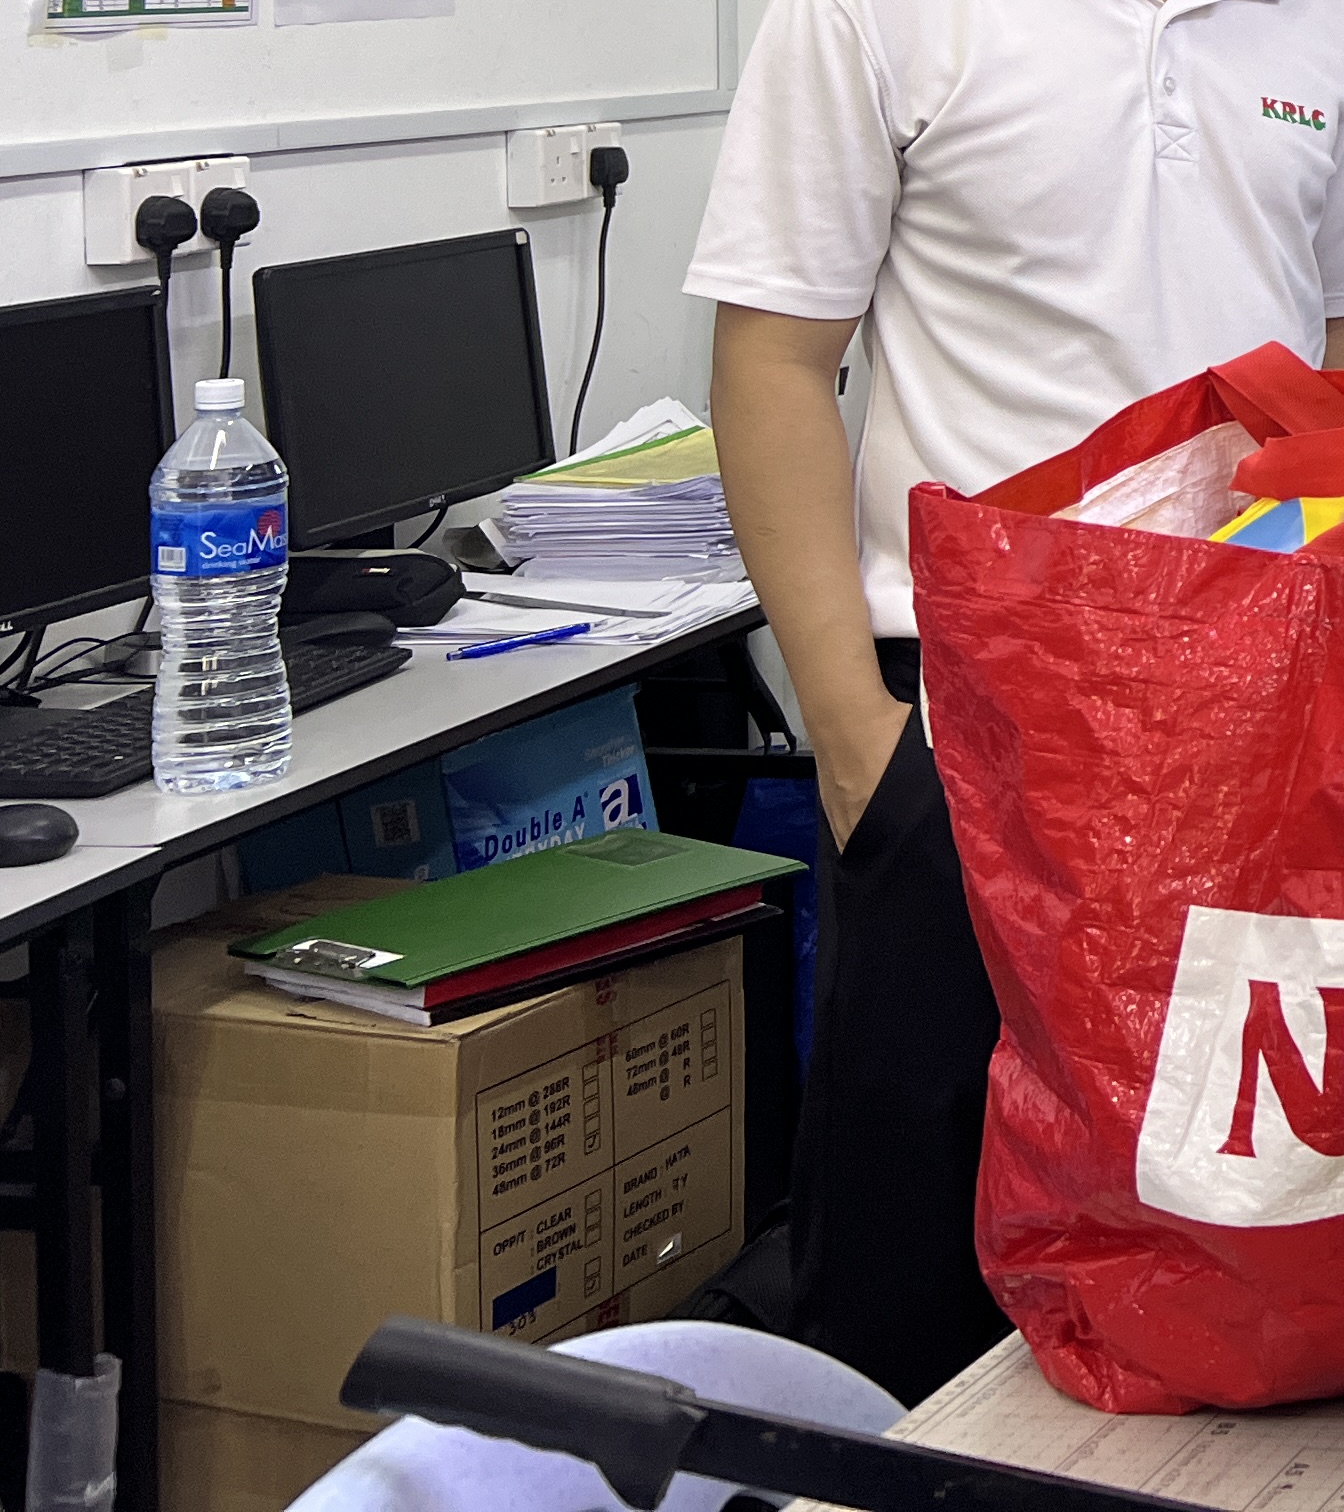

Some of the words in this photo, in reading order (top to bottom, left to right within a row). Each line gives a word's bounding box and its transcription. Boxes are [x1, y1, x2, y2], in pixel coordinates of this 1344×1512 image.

[1260, 96, 1326, 131] KRLC
[484, 809, 563, 863] Double
[572, 796, 586, 823] A
[683, 1057, 690, 1070] R
[684, 1075, 690, 1088] R
[492, 1100, 525, 1123] 12mm
[528, 1091, 540, 1107] @
[528, 1109, 541, 1126] @
[543, 1094, 570, 1116] 192R
[492, 1136, 526, 1160] 24mm
[529, 1127, 541, 1144] @
[544, 1112, 571, 1135] 144R
[492, 1154, 527, 1179] 36mm
[529, 1146, 541, 1163] @
[530, 1165, 542, 1181] @
[544, 1152, 566, 1172] 72R
[623, 1167, 658, 1195] BRAND
[623, 1189, 662, 1219] LENGTH
[536, 1207, 572, 1235] CLEAR
[623, 1208, 669, 1243] CHECKED
[671, 1200, 685, 1217] BY
[536, 1223, 576, 1254] BROWN
[536, 1240, 583, 1271] CRYSTAL
[622, 1243, 648, 1268] DATE
